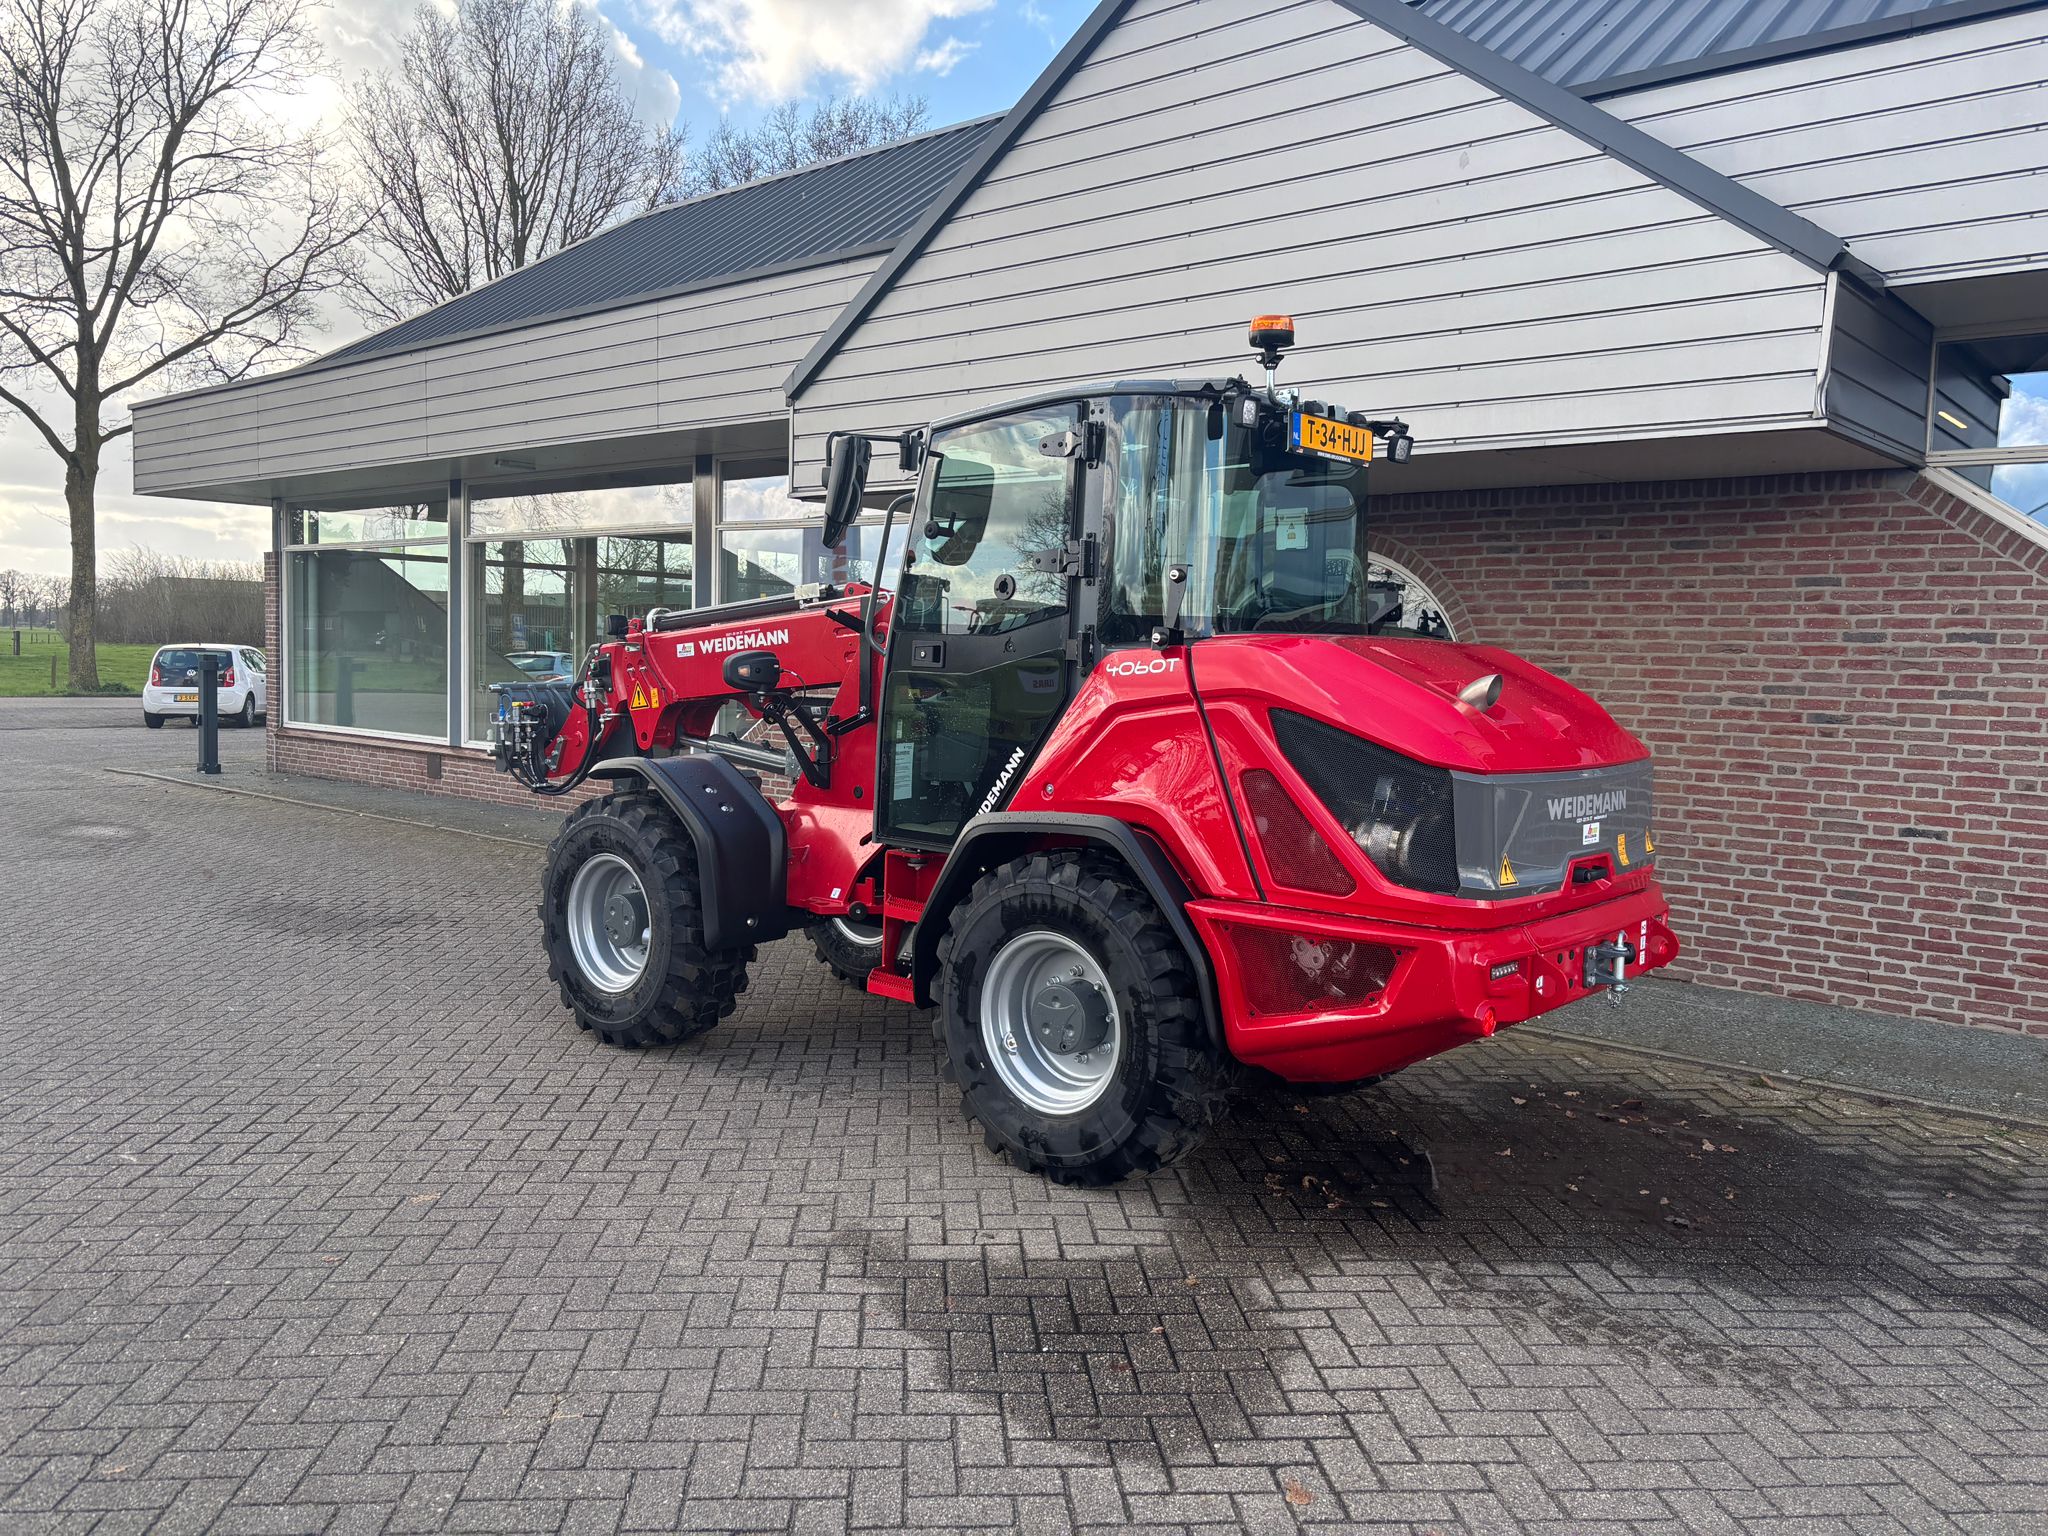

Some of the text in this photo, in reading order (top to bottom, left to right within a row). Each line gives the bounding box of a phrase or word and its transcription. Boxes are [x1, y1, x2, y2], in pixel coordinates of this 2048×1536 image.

[1293, 431, 1300, 440] NL
[1307, 420, 1366, 455] T-34-HJJ
[699, 629, 789, 654] WEIDEMANN
[1106, 657, 1180, 676] 4060T
[976, 747, 1025, 816] IDEMANN
[1547, 789, 1627, 820] WEIDEMANN
